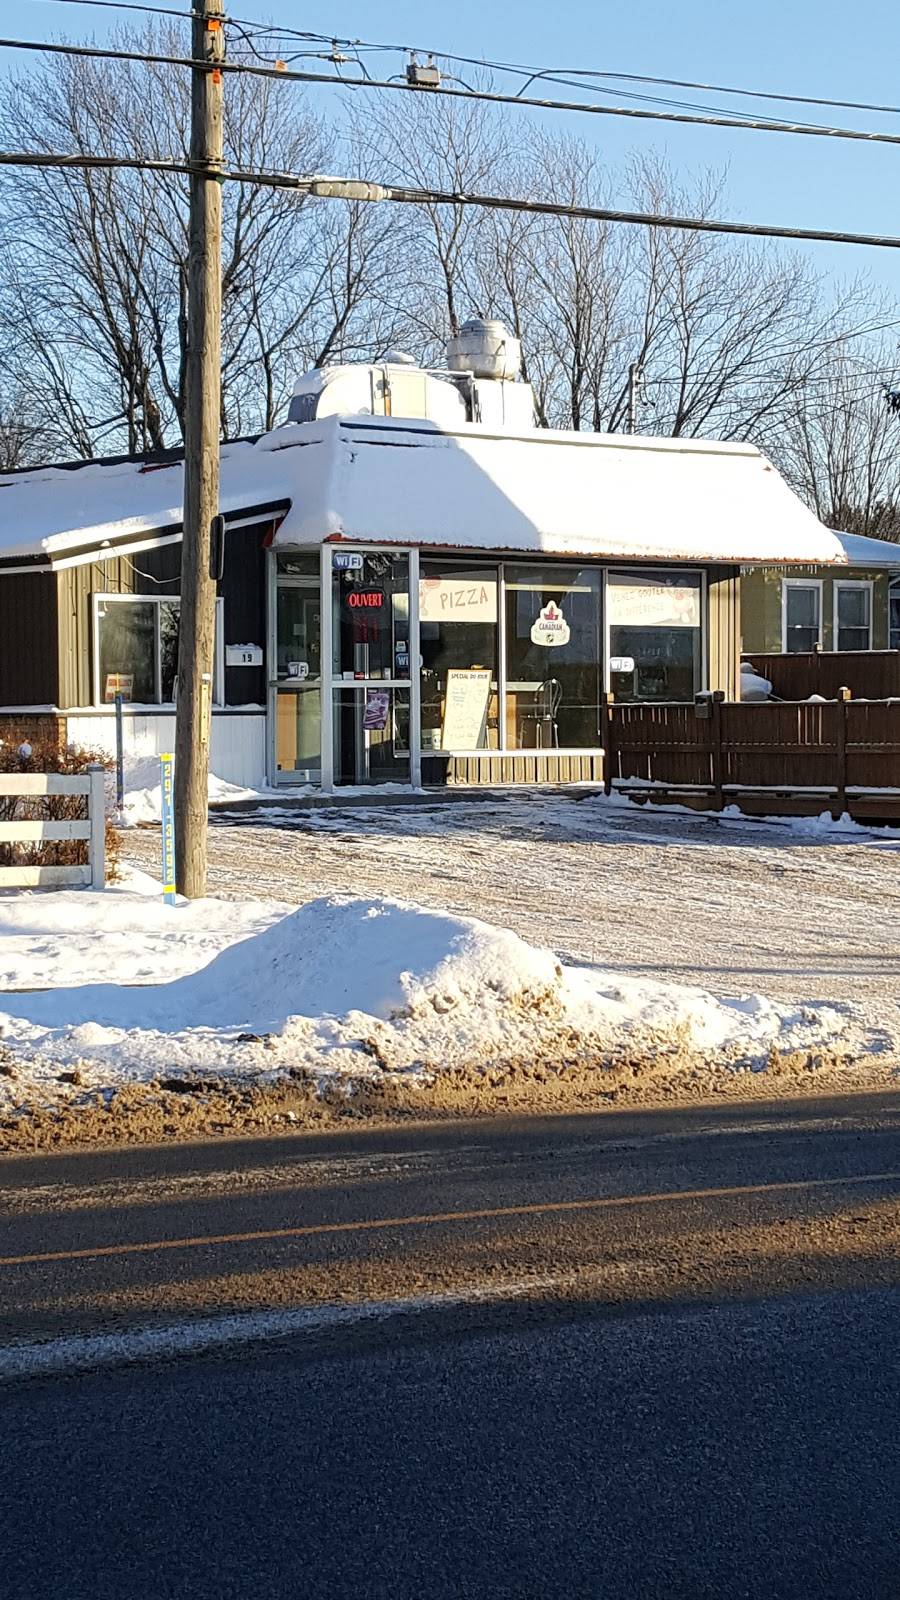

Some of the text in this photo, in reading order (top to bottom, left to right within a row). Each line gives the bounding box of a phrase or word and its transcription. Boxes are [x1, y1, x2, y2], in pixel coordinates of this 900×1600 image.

[349, 593, 383, 607] OUVERT
[439, 585, 488, 610] PIZZA
[538, 622, 563, 631] CANADIAN
[242, 653, 253, 663] 19
